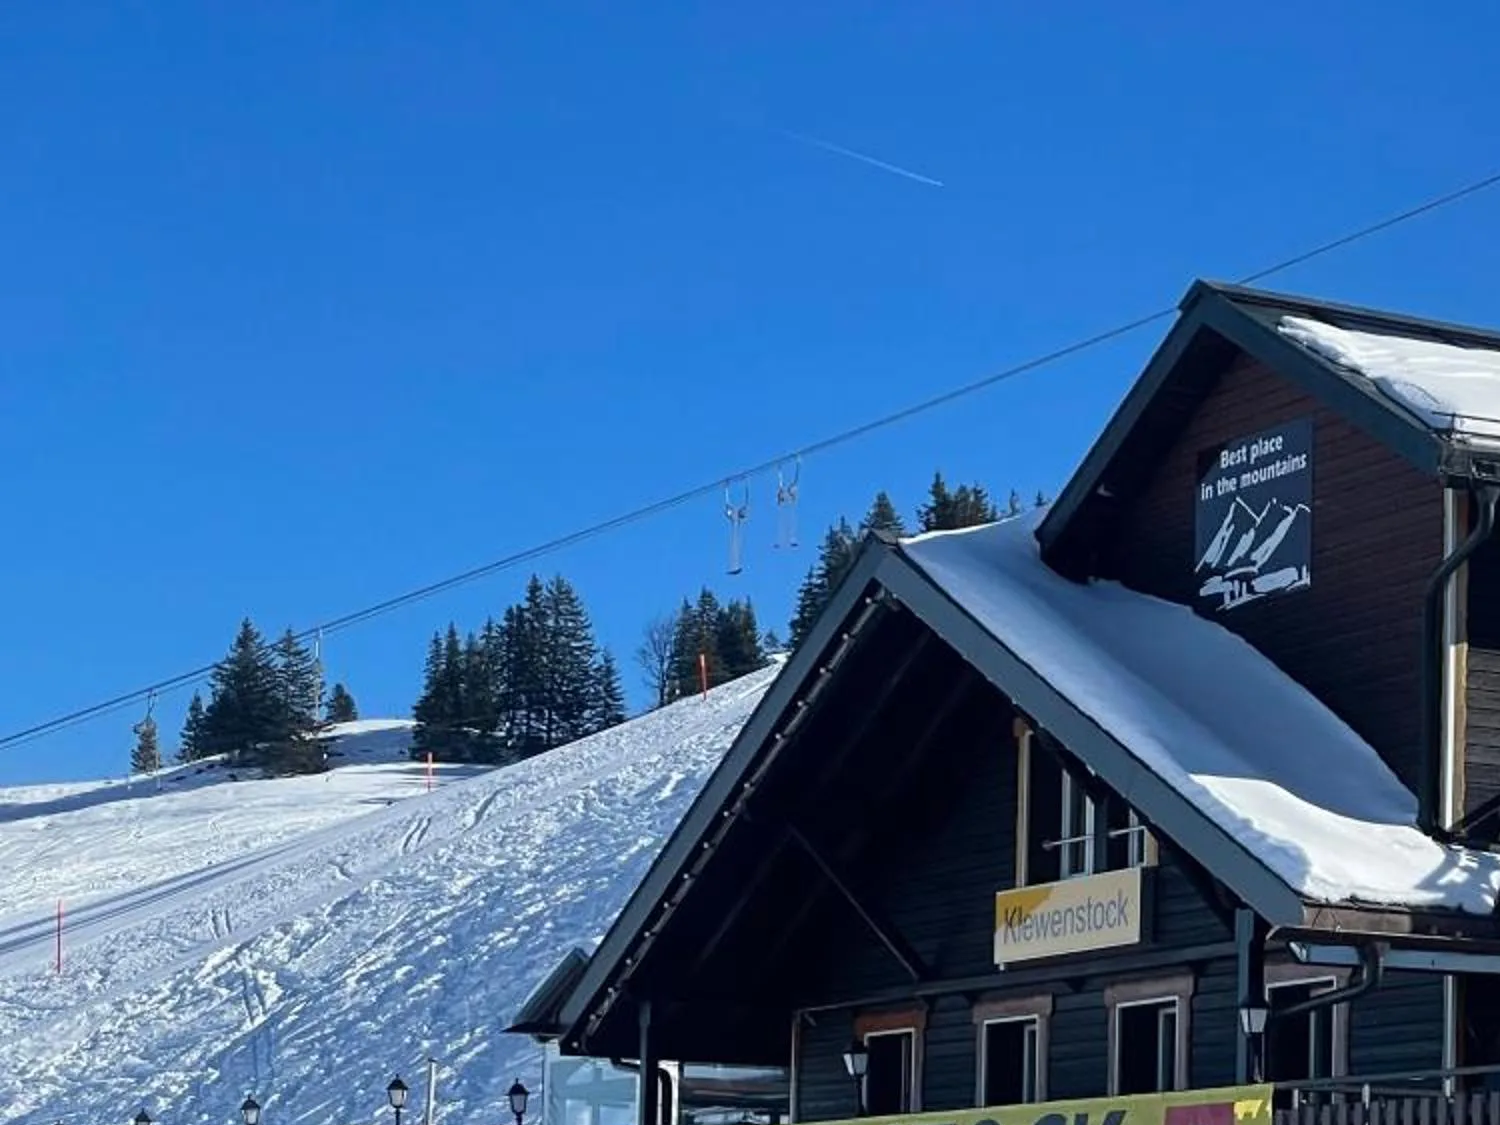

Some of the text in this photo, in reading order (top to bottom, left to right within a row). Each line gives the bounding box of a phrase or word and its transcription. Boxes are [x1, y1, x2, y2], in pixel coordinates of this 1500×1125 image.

[1220, 435, 1283, 469] Best place
[1201, 453, 1307, 500] in the mountains
[1003, 889, 1128, 945] Klewenstock
